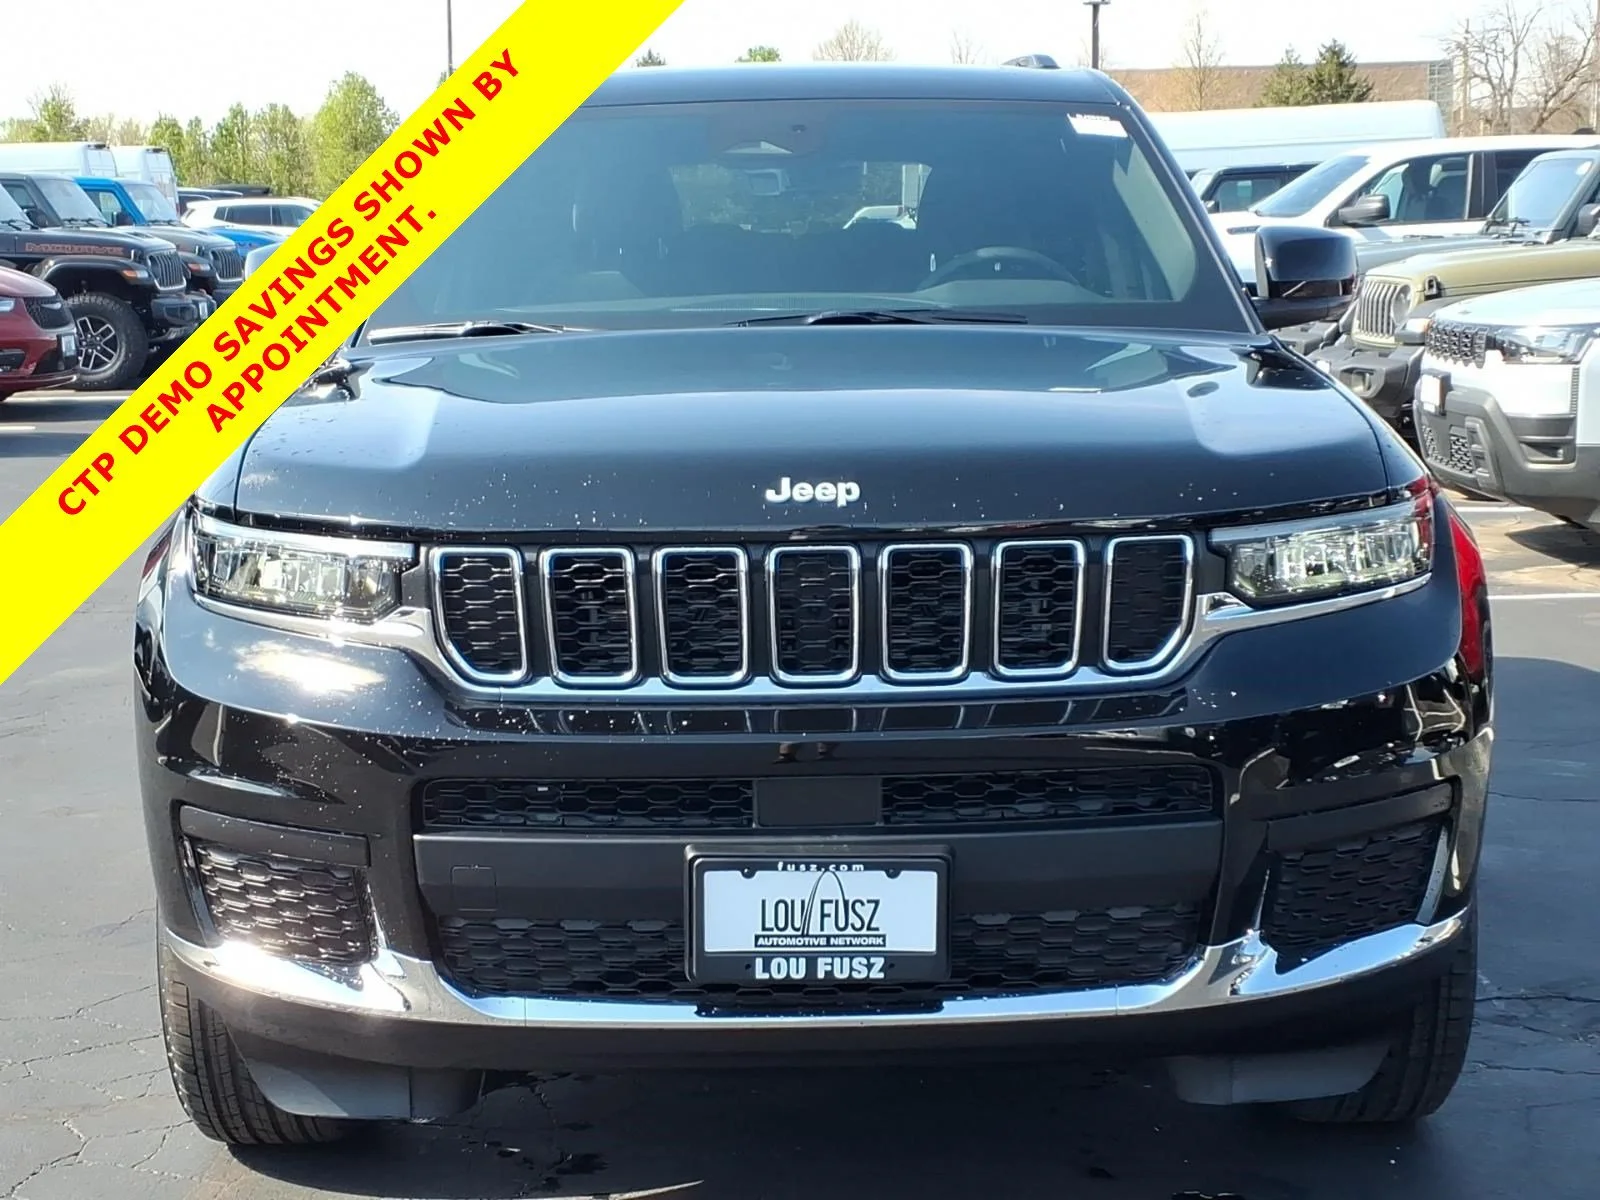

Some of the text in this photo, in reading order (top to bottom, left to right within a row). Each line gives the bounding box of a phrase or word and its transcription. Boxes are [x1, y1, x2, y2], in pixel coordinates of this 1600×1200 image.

[765, 477, 860, 508] Jeep
[777, 861, 865, 872] fusz.com
[761, 899, 880, 932] LOU FUSZ
[757, 937, 884, 946] AUTOMOTIVE NETWORK
[755, 957, 885, 980] LOU FUSZ
